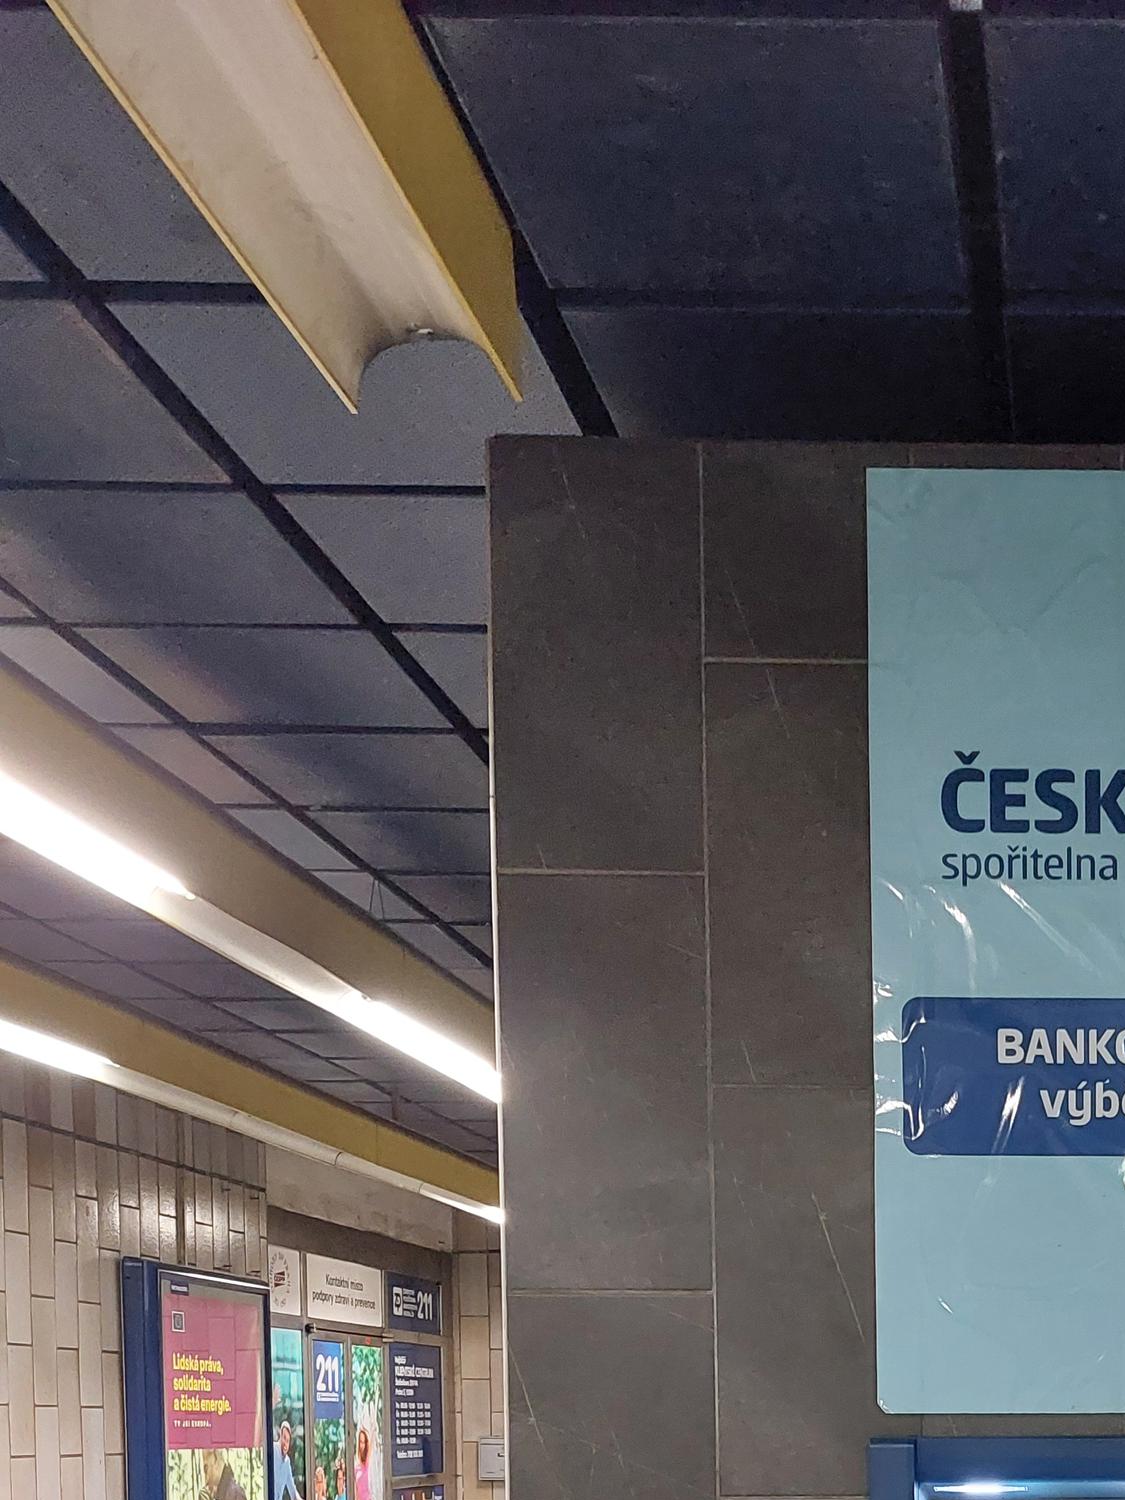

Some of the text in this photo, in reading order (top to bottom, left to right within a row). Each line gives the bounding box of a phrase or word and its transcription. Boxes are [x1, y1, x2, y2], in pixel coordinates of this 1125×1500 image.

[941, 845, 1119, 888] spořitelna
[416, 1290, 433, 1321] 211
[172, 1352, 224, 1376] Lidská práva,
[315, 1353, 340, 1393] 211
[172, 1375, 212, 1393] solidarita
[173, 1394, 232, 1416] a čistá energie.
